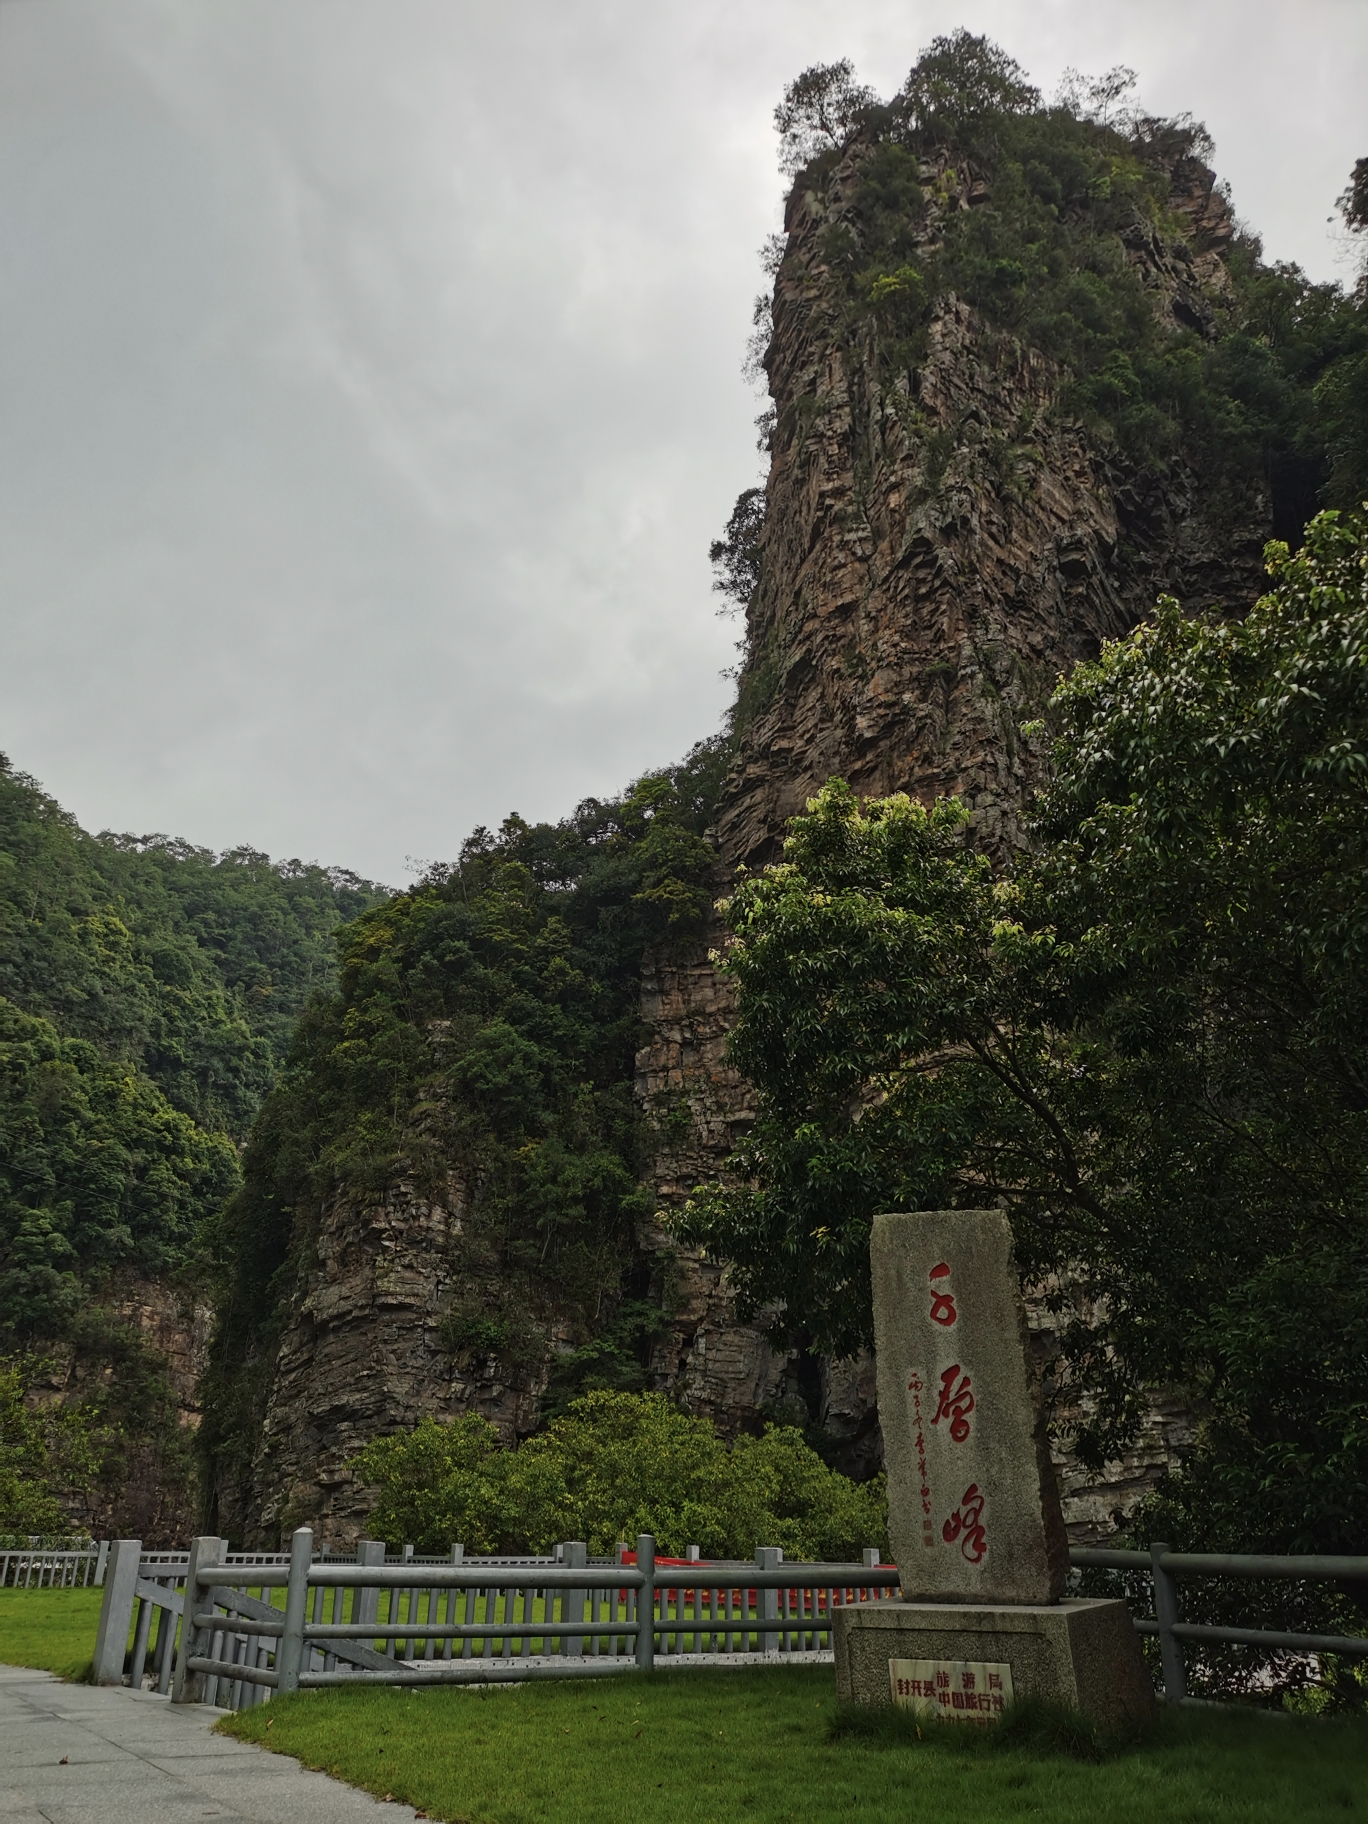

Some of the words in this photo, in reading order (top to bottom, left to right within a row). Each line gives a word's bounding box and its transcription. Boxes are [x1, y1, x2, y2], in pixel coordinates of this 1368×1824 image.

[897, 1678, 936, 1697] 封开县
[936, 1671, 1003, 1690] 旅游局
[938, 1691, 1004, 1711] 中国旅行社
